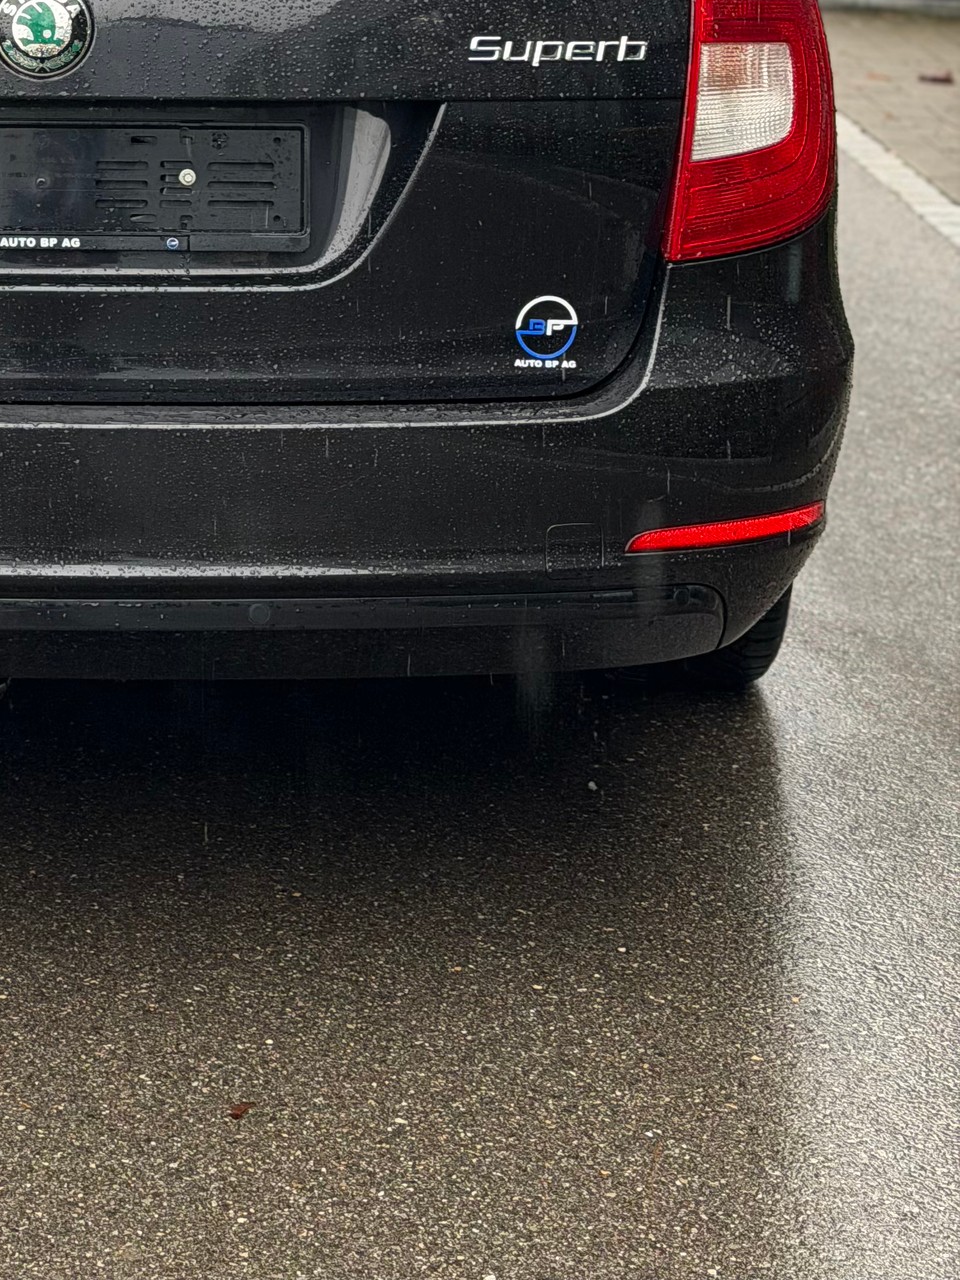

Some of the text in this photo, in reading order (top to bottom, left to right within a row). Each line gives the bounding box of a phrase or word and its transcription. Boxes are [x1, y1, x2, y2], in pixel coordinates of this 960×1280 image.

[468, 35, 648, 67] Superb
[0, 237, 81, 248] AUTO BP AG
[514, 359, 577, 369] AUTO BP AG
